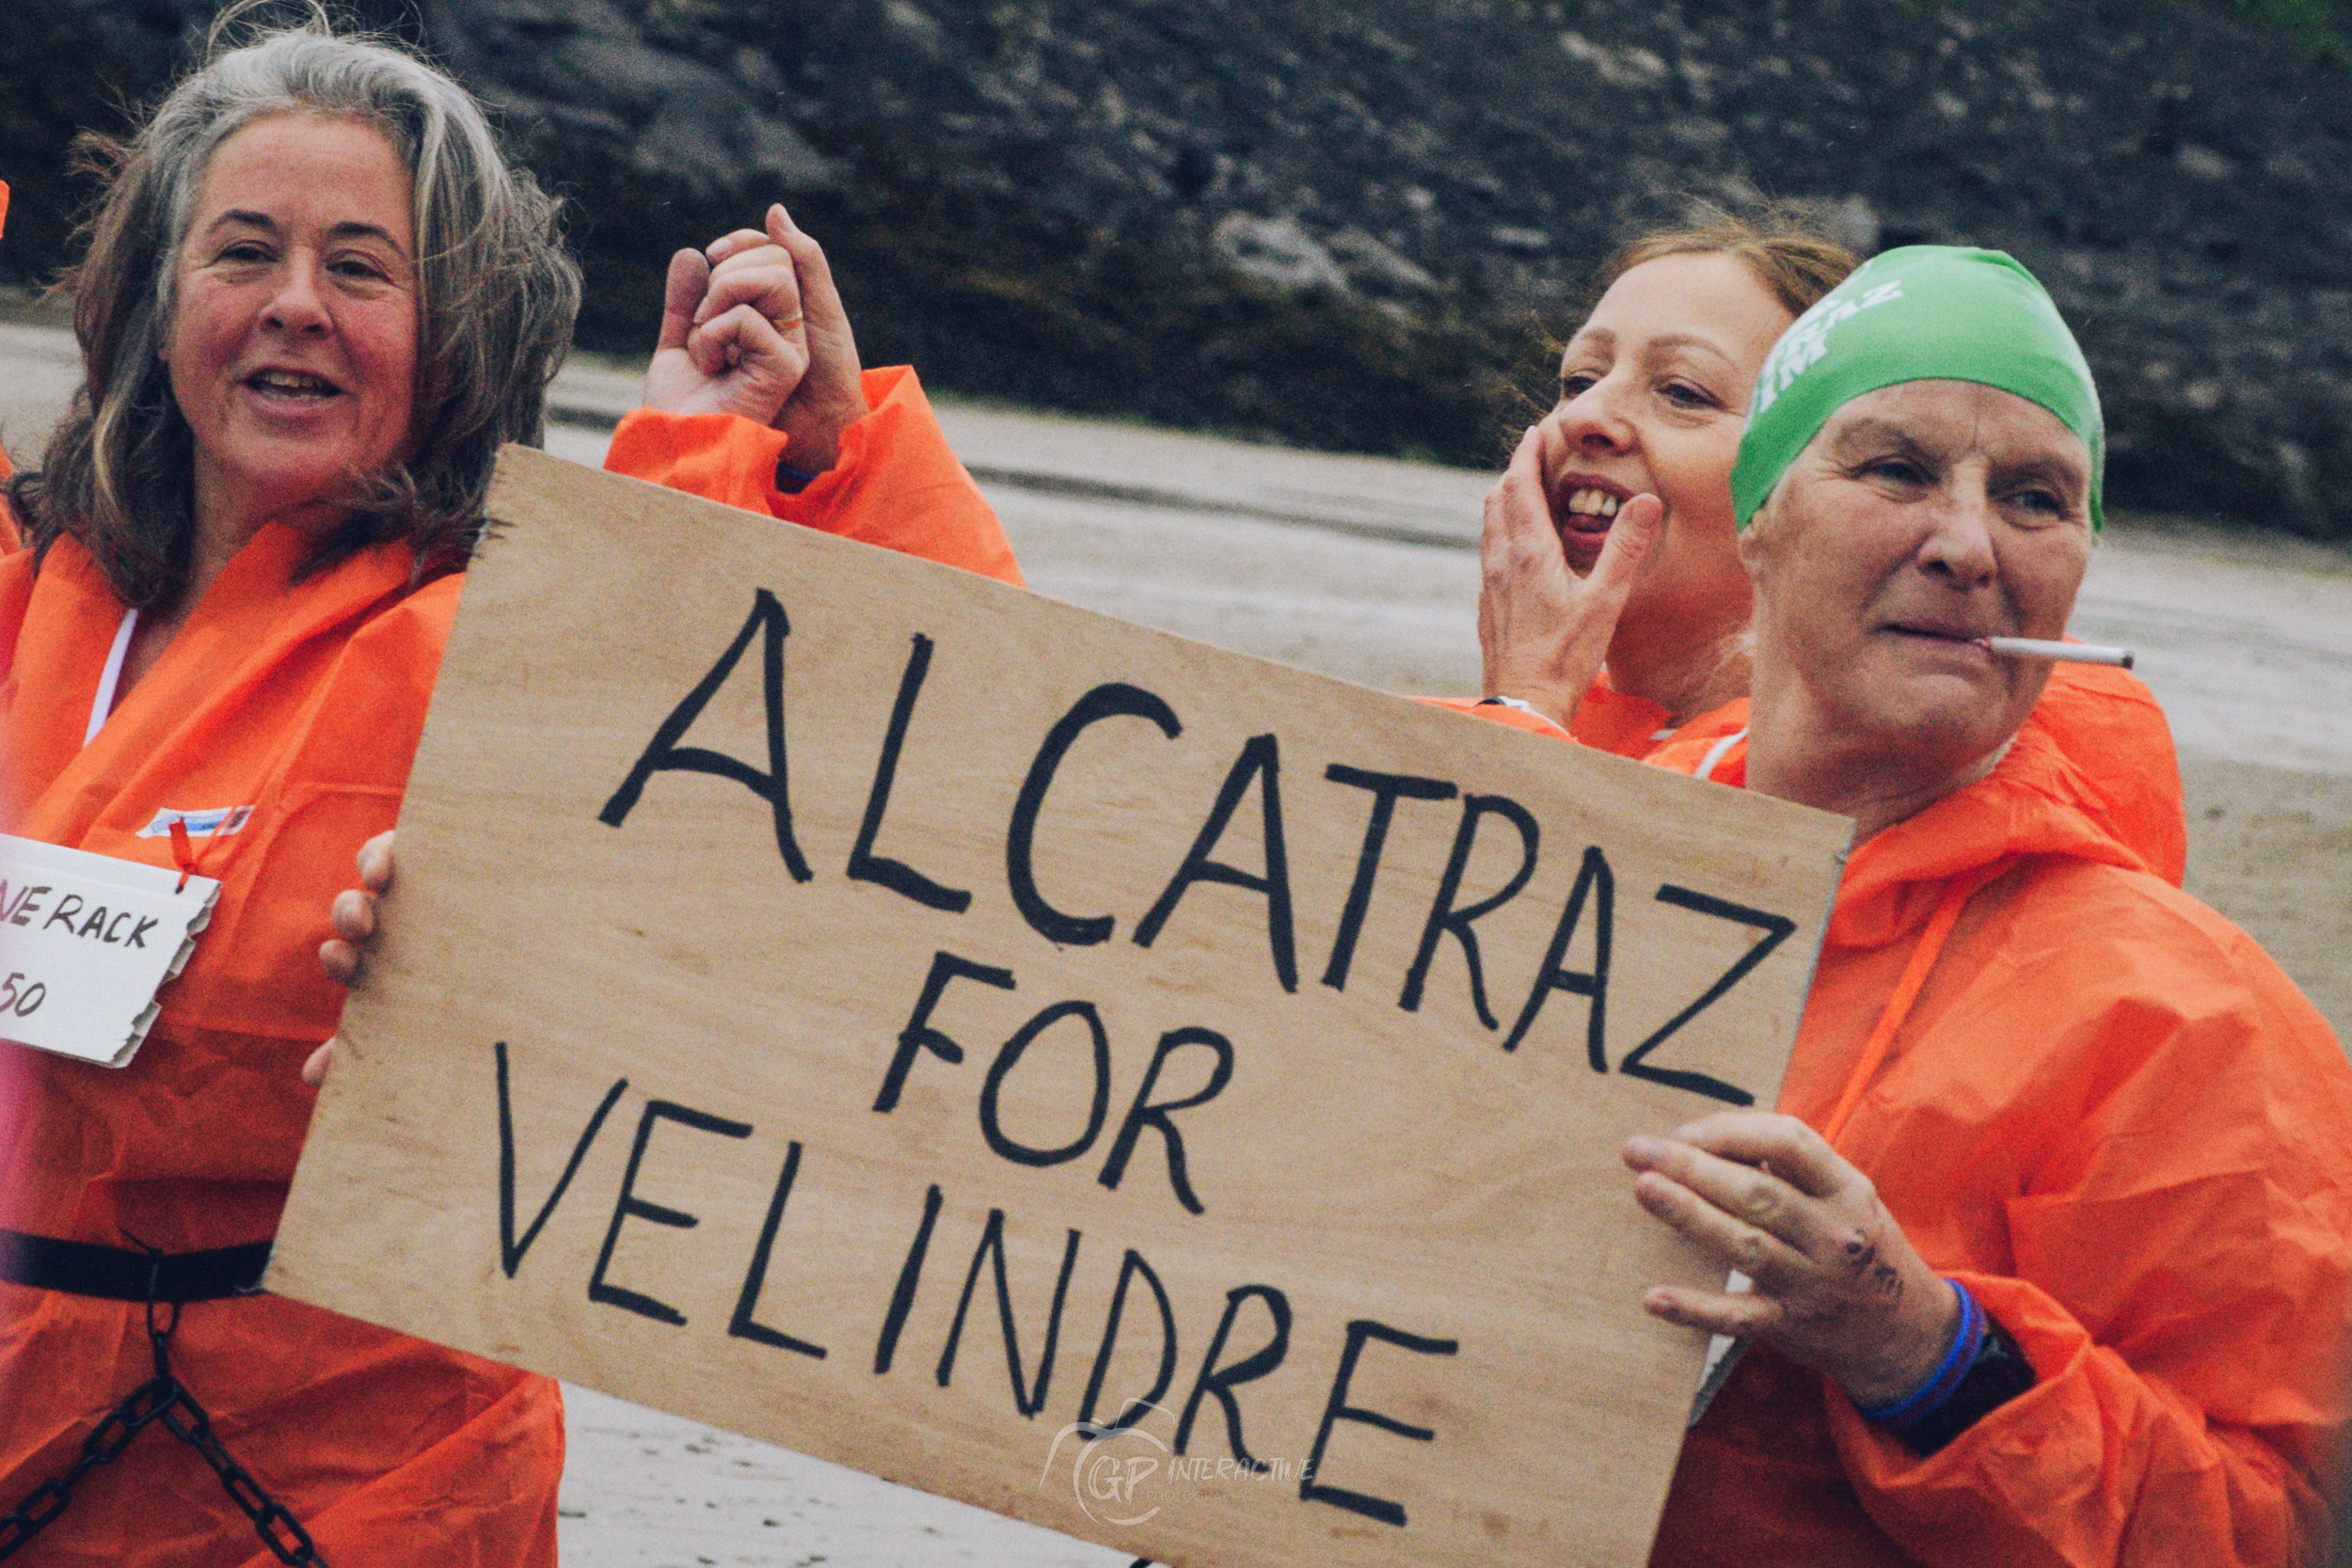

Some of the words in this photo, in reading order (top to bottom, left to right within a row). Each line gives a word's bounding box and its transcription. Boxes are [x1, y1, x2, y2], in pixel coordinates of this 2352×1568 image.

[42, 894, 158, 950] RACK
[598, 588, 1796, 1106] ALCATRAZ
[0, 972, 46, 1018] 50
[872, 952, 1233, 1214] FOR
[495, 1042, 1458, 1528] VELINDRE
